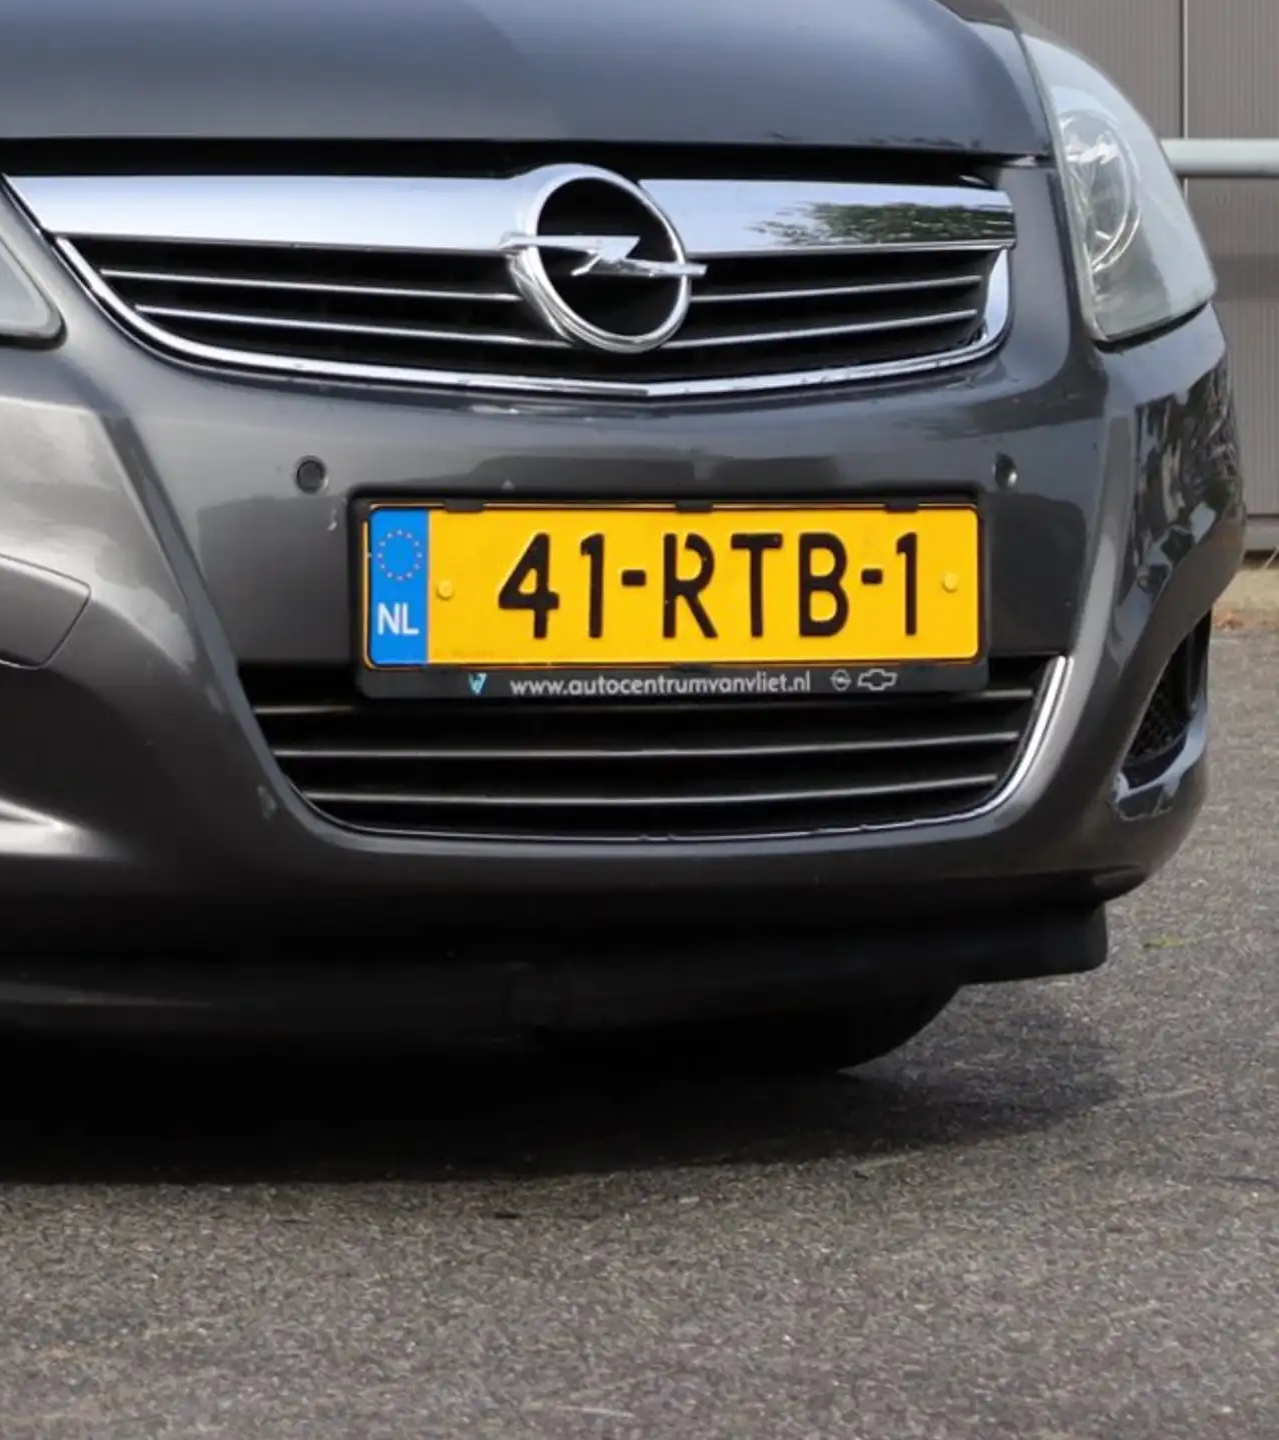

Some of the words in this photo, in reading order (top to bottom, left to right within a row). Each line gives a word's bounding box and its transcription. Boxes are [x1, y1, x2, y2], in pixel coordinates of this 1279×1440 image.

[498, 532, 918, 639] 41-RTB-1
[378, 604, 419, 635] NL
[510, 670, 812, 695] www.autocentrumvanvliet.nl
